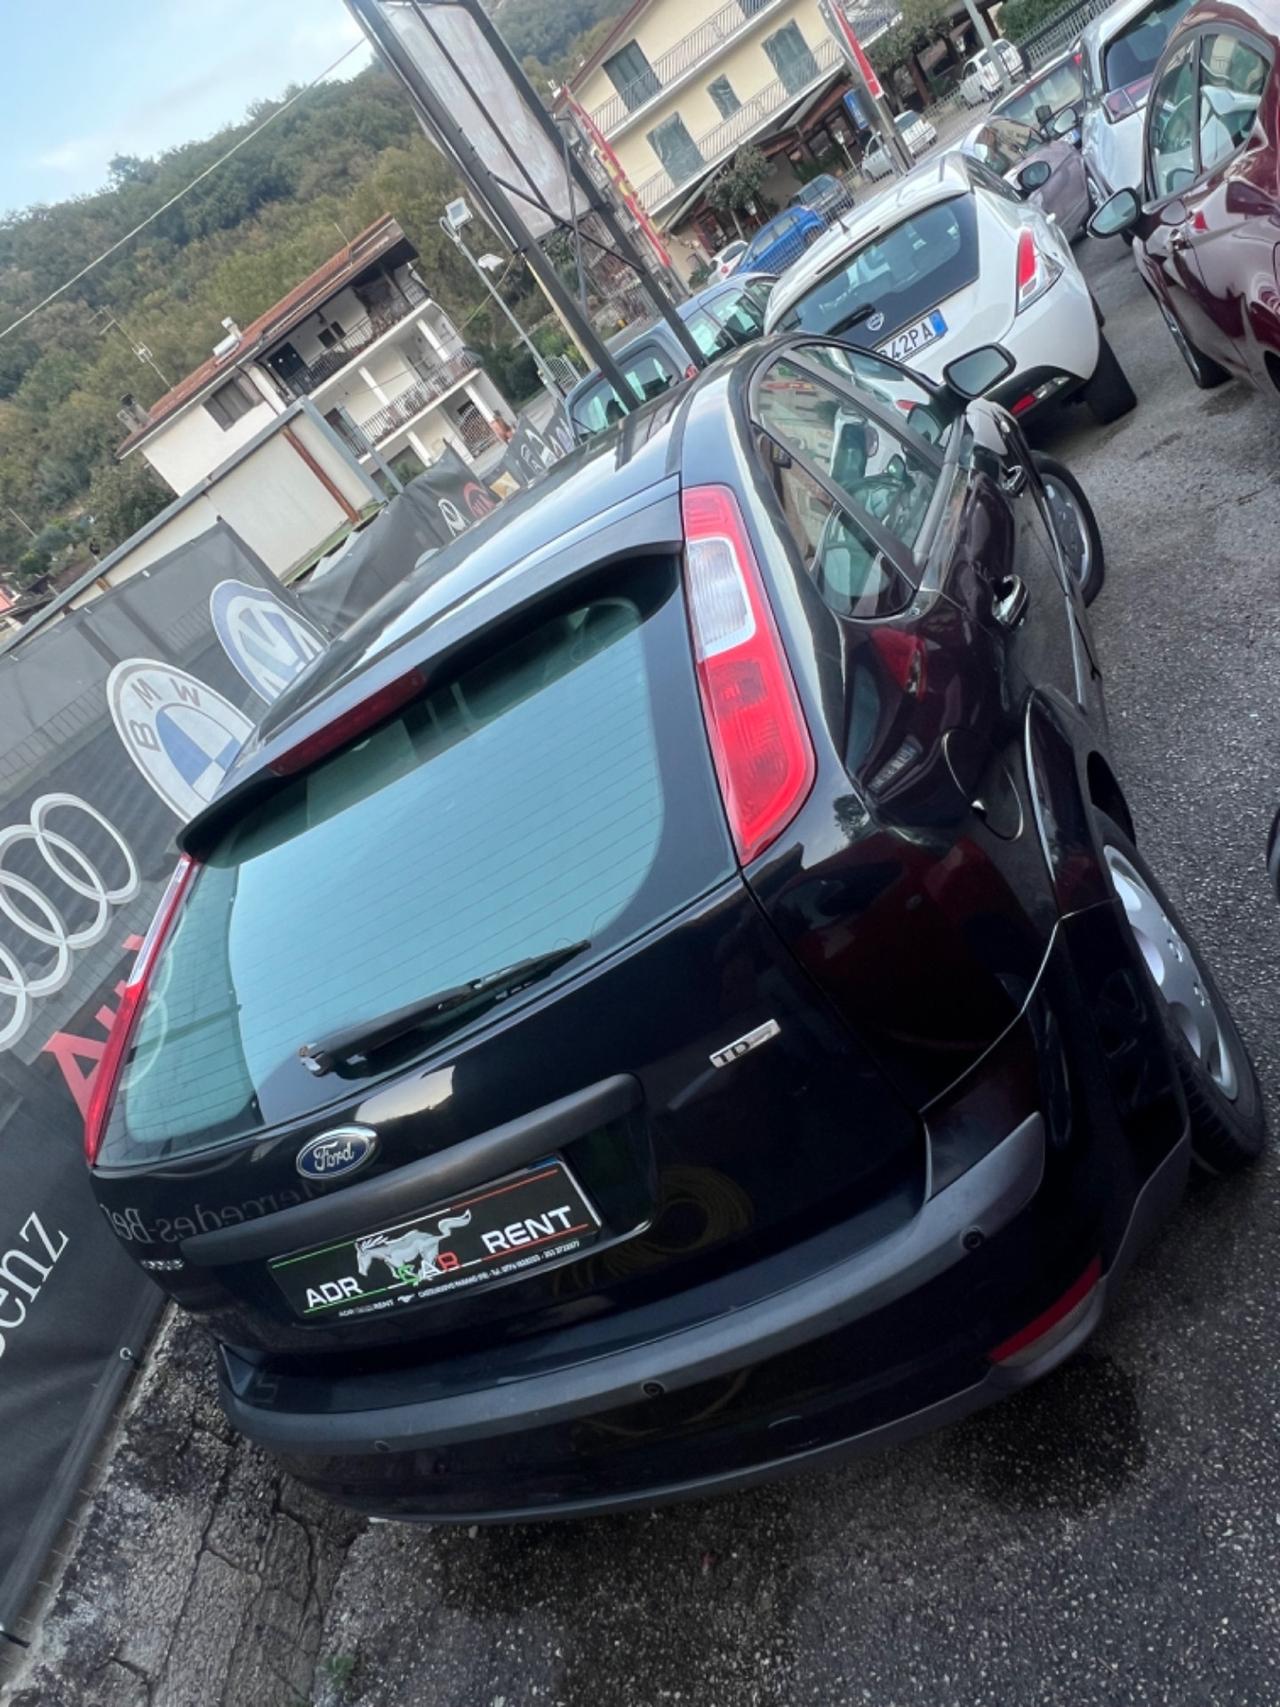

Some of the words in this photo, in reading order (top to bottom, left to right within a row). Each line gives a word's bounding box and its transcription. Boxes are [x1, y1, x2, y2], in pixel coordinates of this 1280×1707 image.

[130, 678, 200, 753] BMW
[312, 1142, 354, 1172] Ford
[0, 1211, 69, 1340] enz
[305, 1276, 362, 1308] ADR
[481, 1205, 571, 1254] RENT
